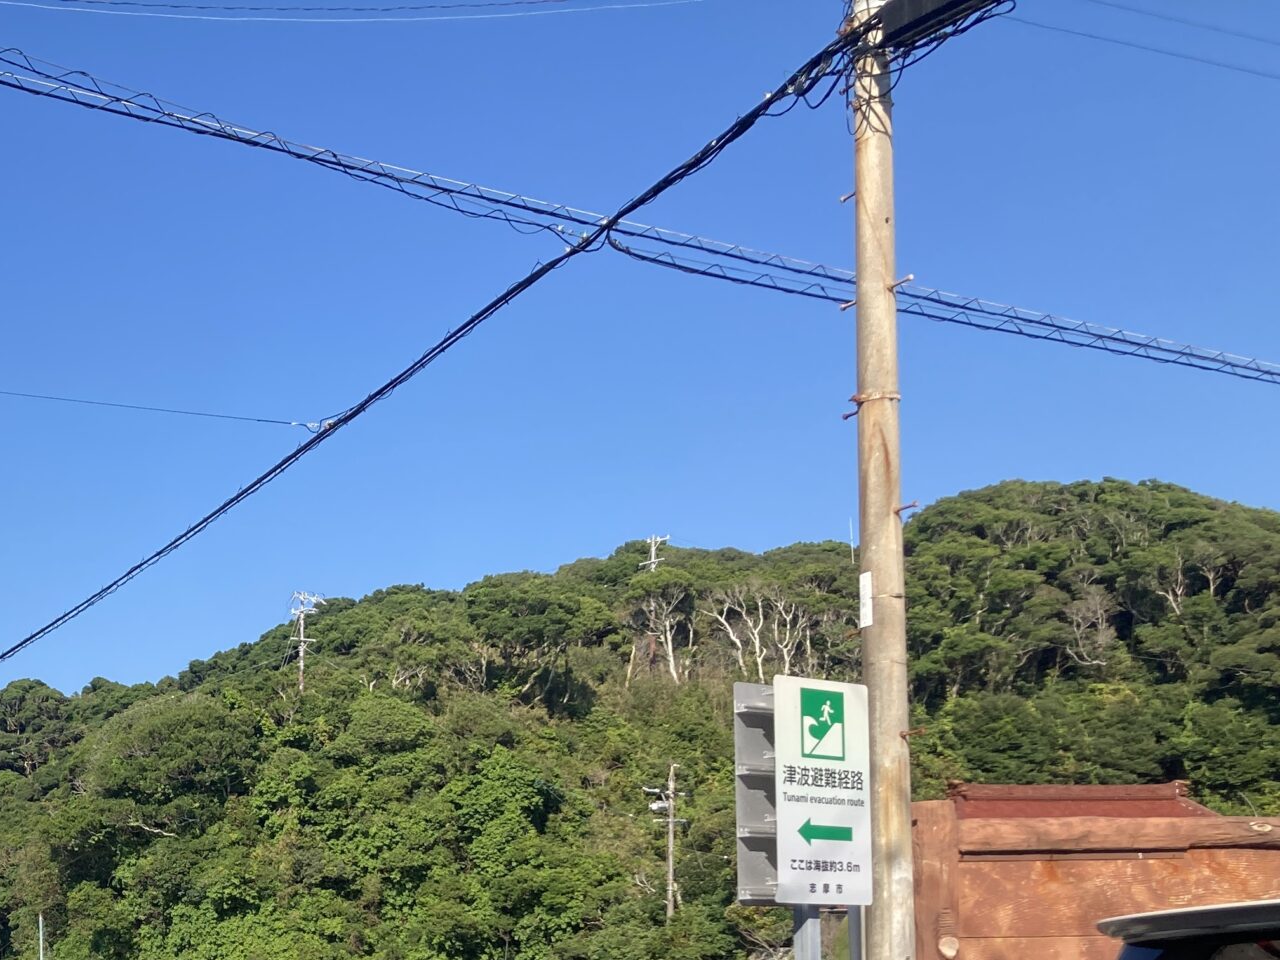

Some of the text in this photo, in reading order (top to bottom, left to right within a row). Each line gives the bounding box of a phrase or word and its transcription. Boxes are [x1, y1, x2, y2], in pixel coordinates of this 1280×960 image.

[782, 765, 864, 791] 津波避難経路
[782, 792, 865, 807] Tunami evacuation route
